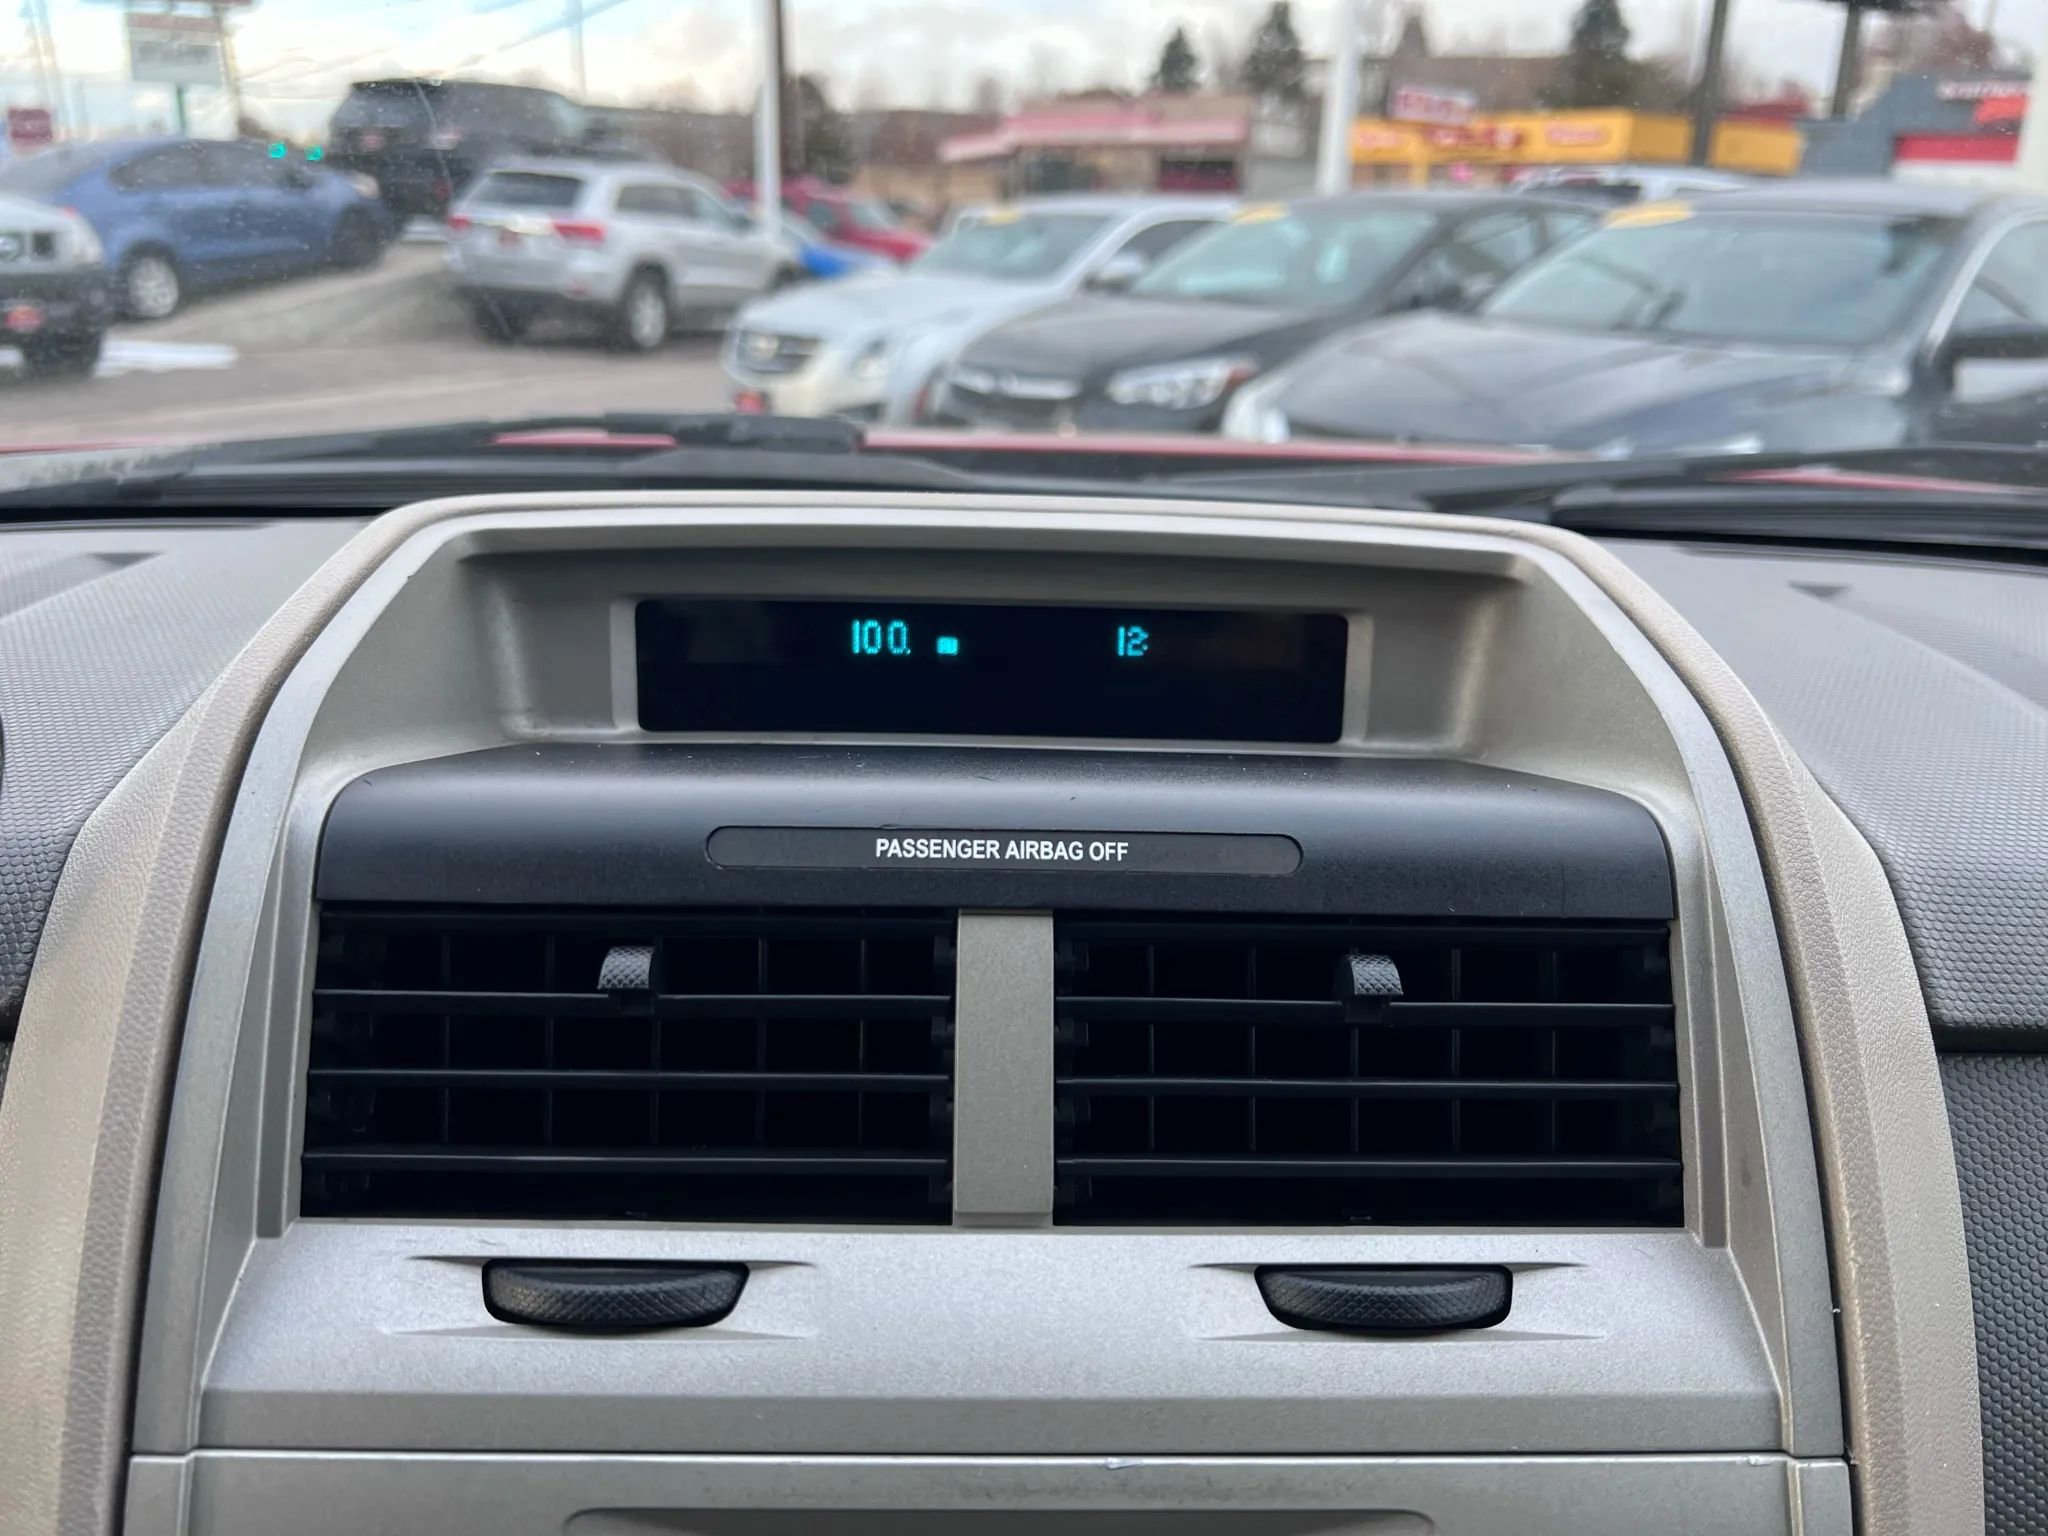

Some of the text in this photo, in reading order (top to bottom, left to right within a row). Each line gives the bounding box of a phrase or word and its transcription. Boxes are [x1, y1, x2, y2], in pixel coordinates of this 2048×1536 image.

[875, 838, 1129, 861] PASSENGER AIRBAG OFF
